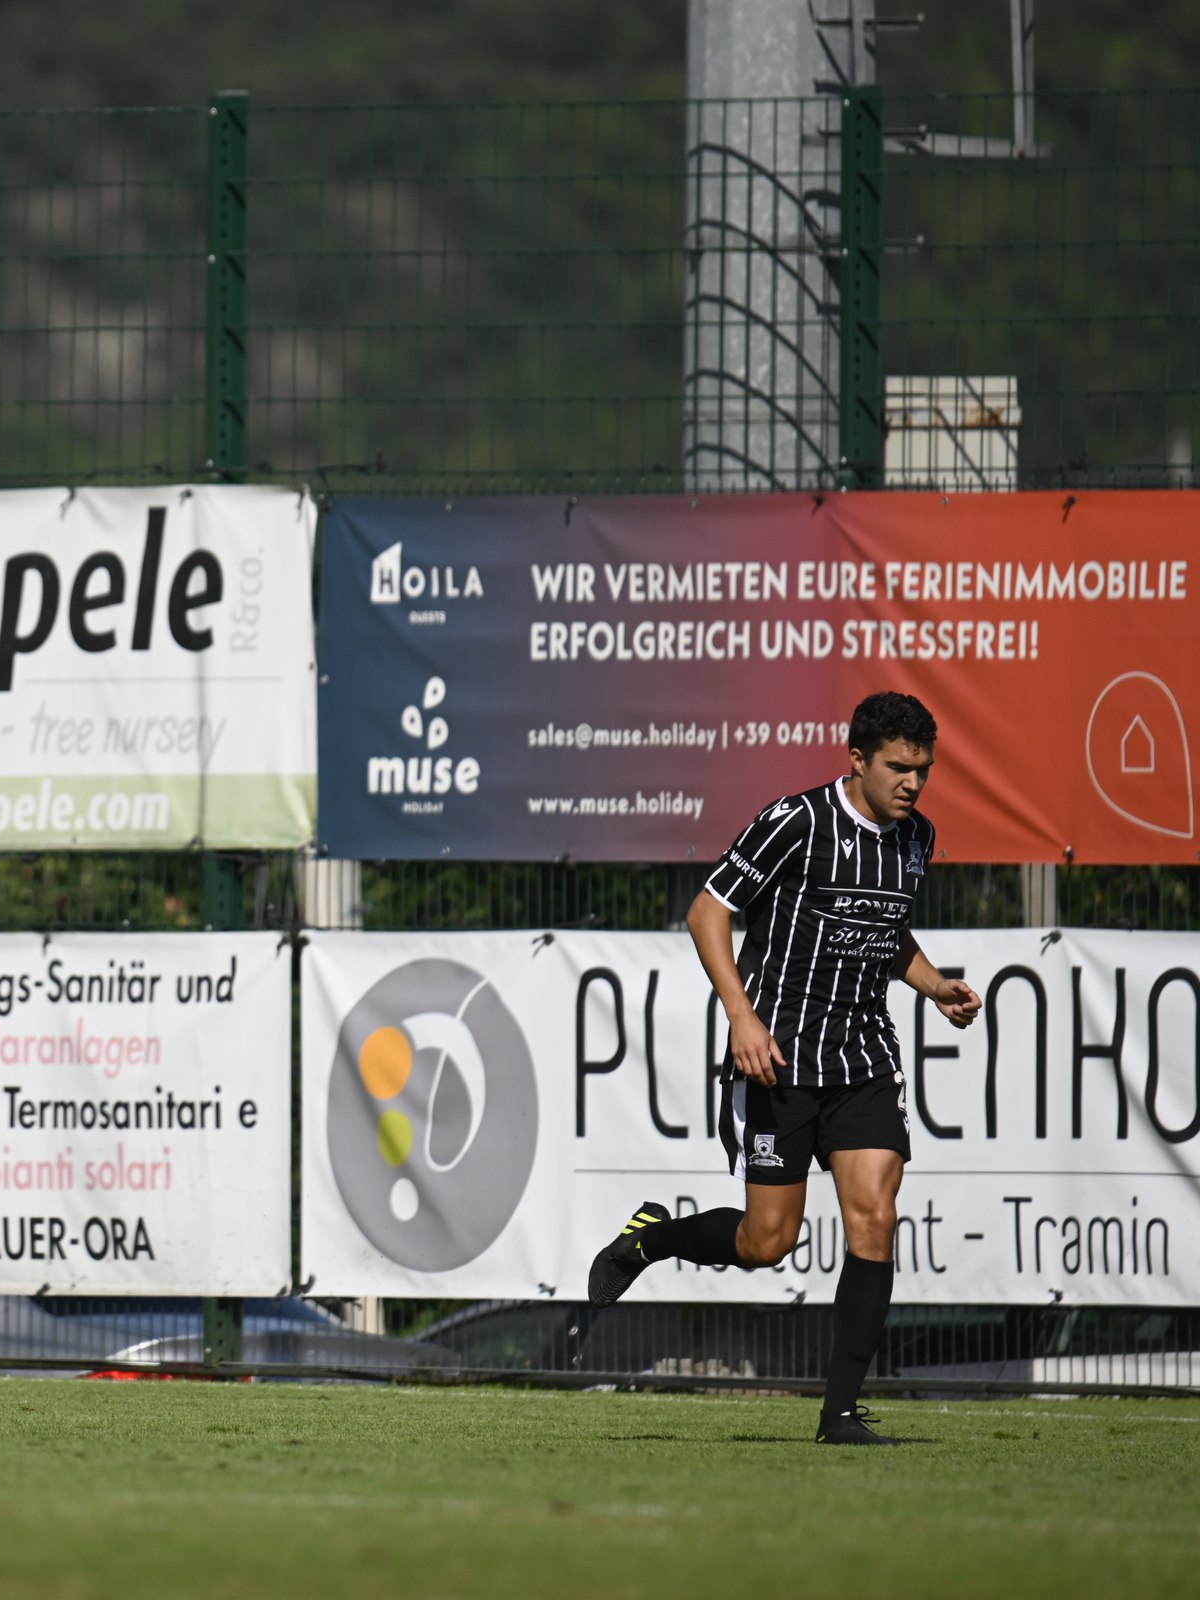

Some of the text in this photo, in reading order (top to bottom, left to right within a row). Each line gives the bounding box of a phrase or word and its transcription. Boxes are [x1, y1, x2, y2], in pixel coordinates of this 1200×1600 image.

[531, 560, 1187, 603] WIR VERMIETEN EURE FERIENIMMOBILIE
[530, 620, 1039, 661] ERFOLGREICH UND STRESSFREI!
[30, 701, 96, 755] tree
[103, 713, 228, 762] nursery
[528, 721, 716, 752] sales@muse.holiday
[734, 721, 770, 746] +39
[776, 720, 824, 746] 0471
[368, 756, 480, 795] muse
[529, 792, 703, 820] www.muse.holiday
[730, 850, 764, 883] WÜRTH
[829, 926, 861, 944] 50
[177, 955, 237, 1002] und
[3, 1086, 222, 1130] Termosanitari
[239, 1100, 258, 1128] e
[85, 1142, 172, 1191] solari
[1004, 1196, 1170, 1276] Tramin
